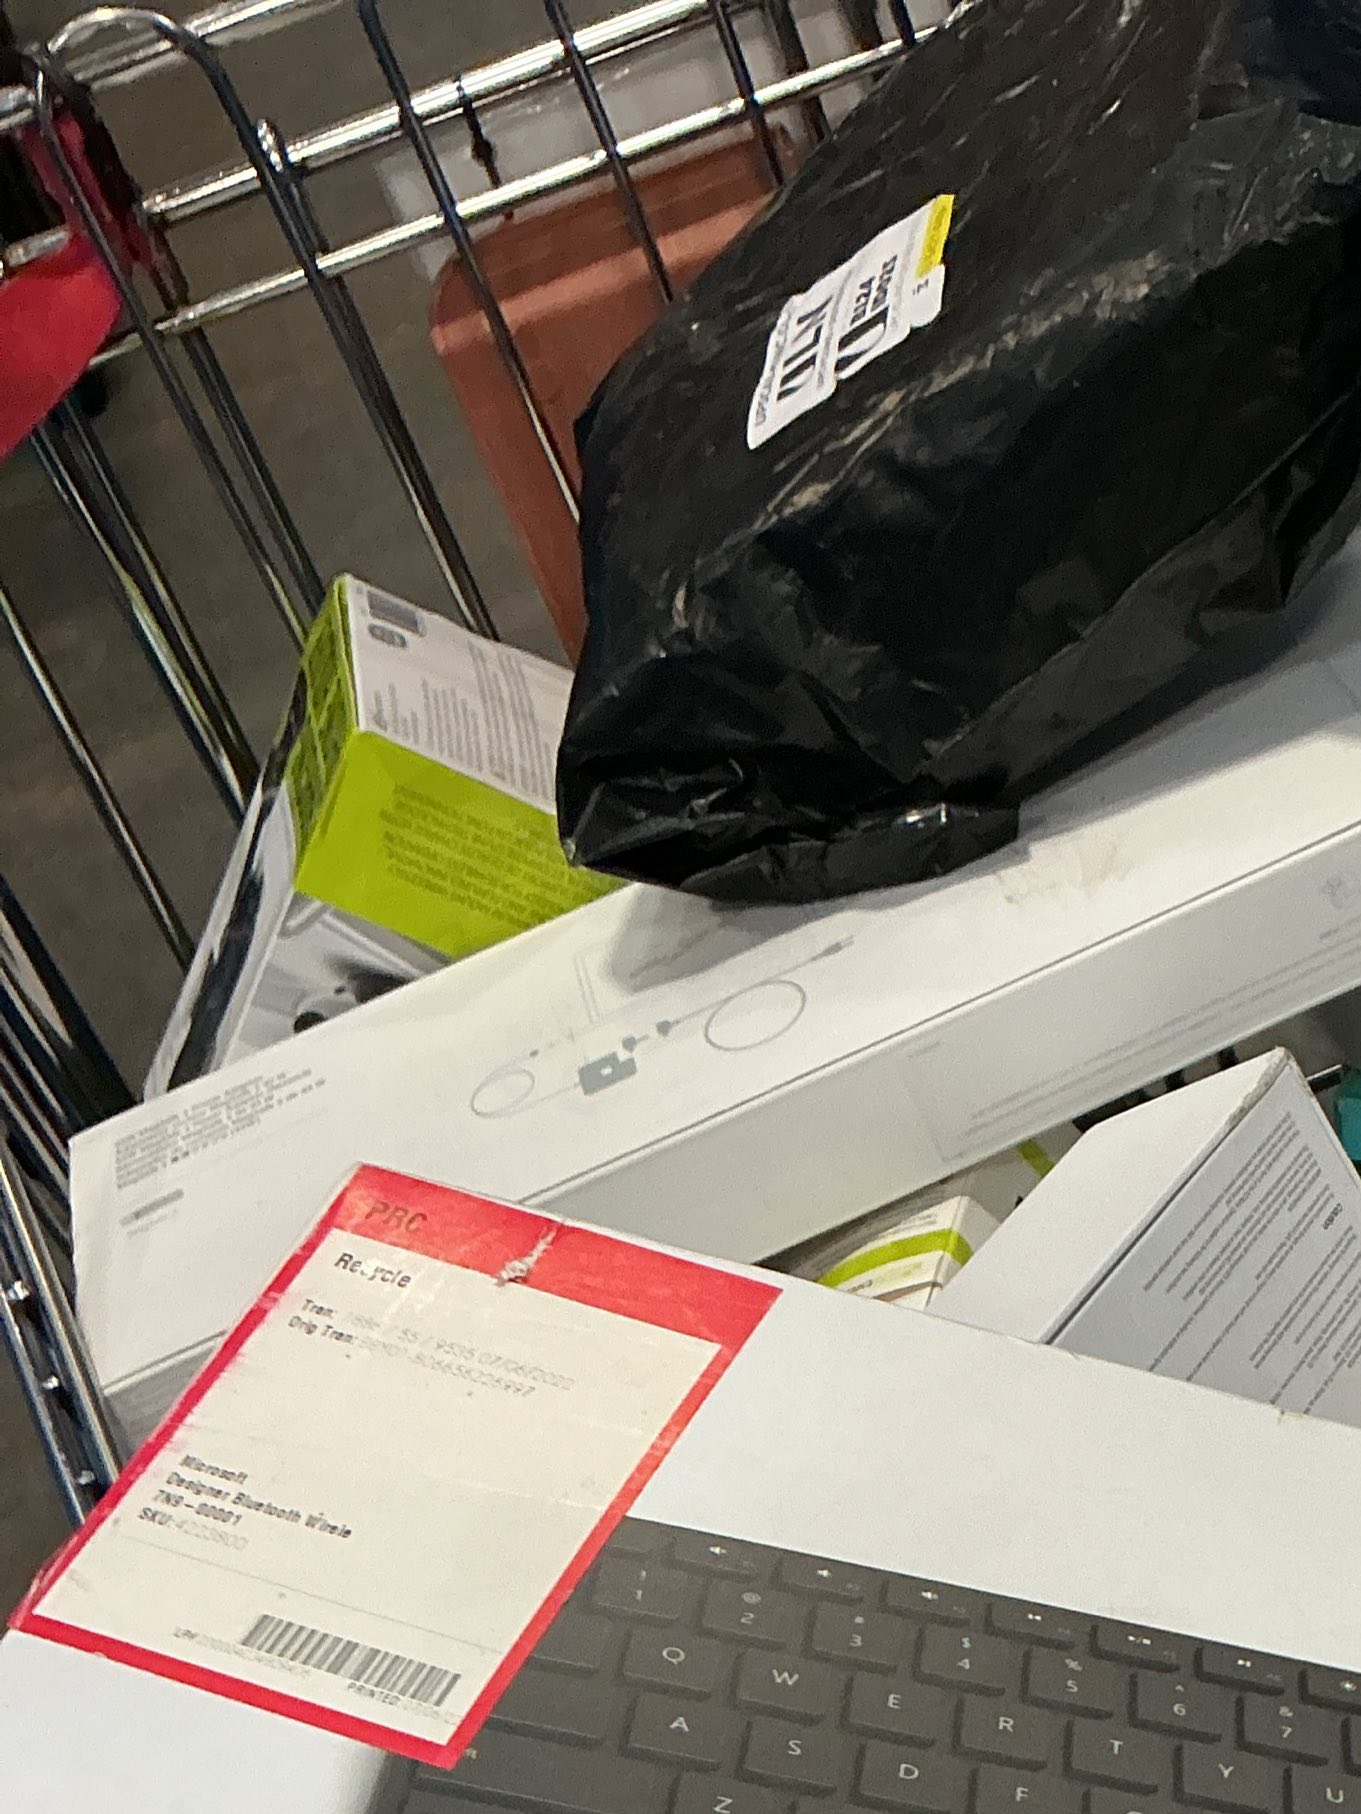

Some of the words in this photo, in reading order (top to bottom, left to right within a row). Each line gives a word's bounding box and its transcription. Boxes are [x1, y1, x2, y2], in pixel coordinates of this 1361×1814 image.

[364, 1198, 433, 1235] PRC
[179, 1454, 249, 1485] Microsoft
[165, 1471, 231, 1501] Designer
[231, 1491, 302, 1523] Bluetooth
[661, 1646, 686, 1665] Q
[772, 1669, 799, 1686] W
[887, 1693, 901, 1710] E
[669, 1716, 690, 1732] A
[998, 1716, 1015, 1733] R
[787, 1739, 802, 1756] S
[1109, 1739, 1124, 1755] T
[898, 1763, 920, 1780] D
[1218, 1763, 1234, 1779] Y
[1015, 1786, 1029, 1802] F
[1325, 1787, 1344, 1804] U
[713, 1795, 733, 1814] Z
